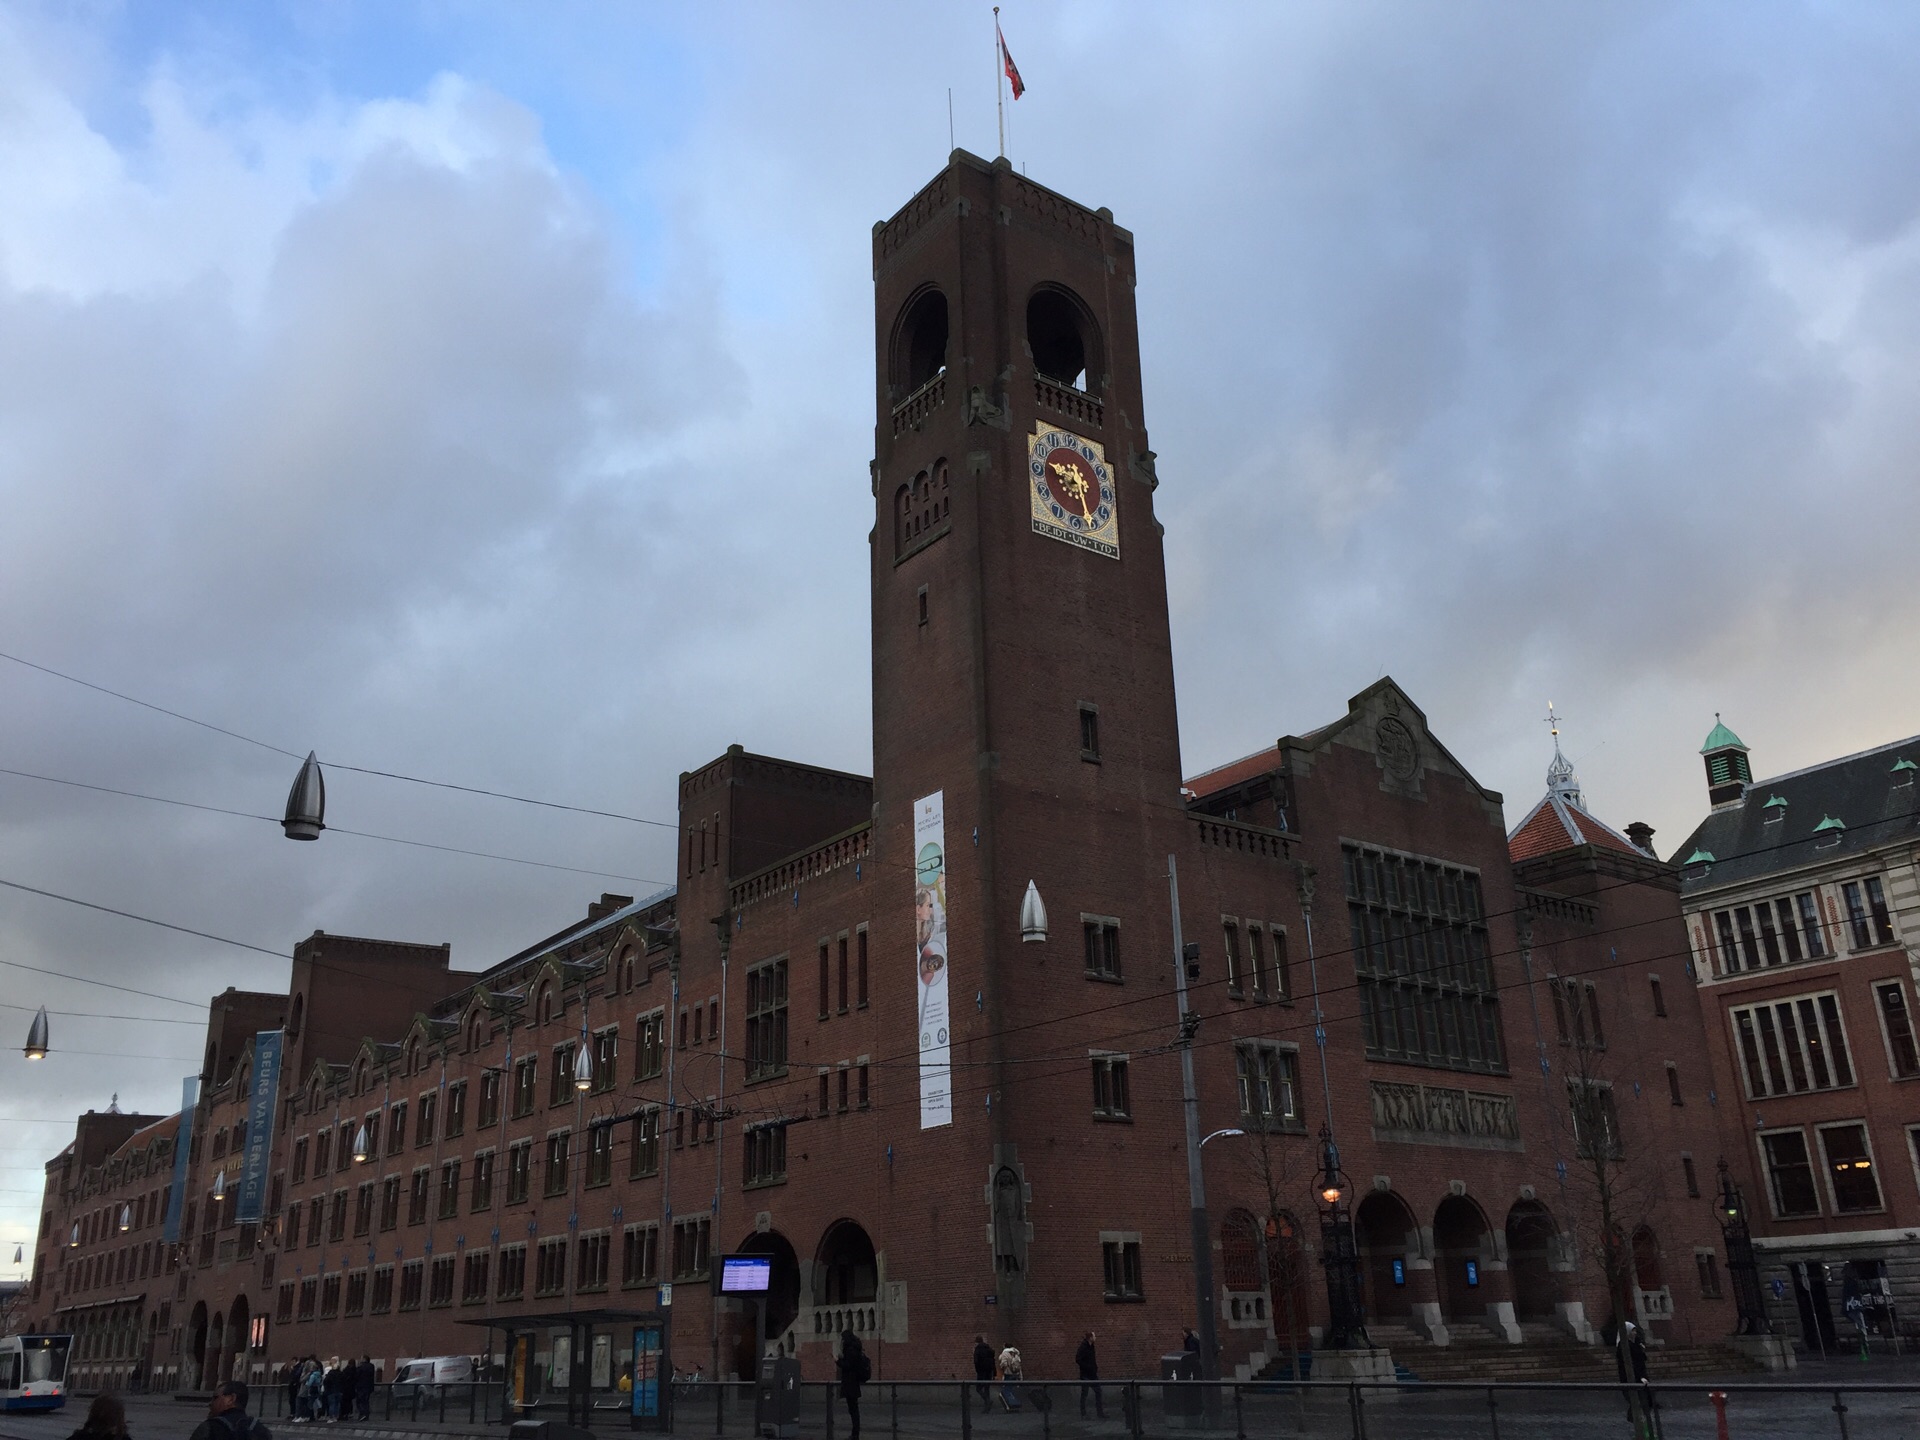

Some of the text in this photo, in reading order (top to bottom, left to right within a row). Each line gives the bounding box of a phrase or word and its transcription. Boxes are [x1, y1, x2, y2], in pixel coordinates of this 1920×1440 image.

[1050, 434, 1057, 447] 11
[1066, 435, 1075, 448] 12
[1037, 443, 1046, 457] 10
[1034, 463, 1042, 473] 9
[1098, 468, 1105, 479] 2
[1040, 485, 1047, 498] 8
[1104, 488, 1111, 501] 3
[1054, 505, 1061, 517] 7
[1072, 517, 1081, 529] 6
[1039, 522, 1112, 553] BEIDT UW TYD
[246, 1050, 272, 1199] BEURS VAN BERLAGE
